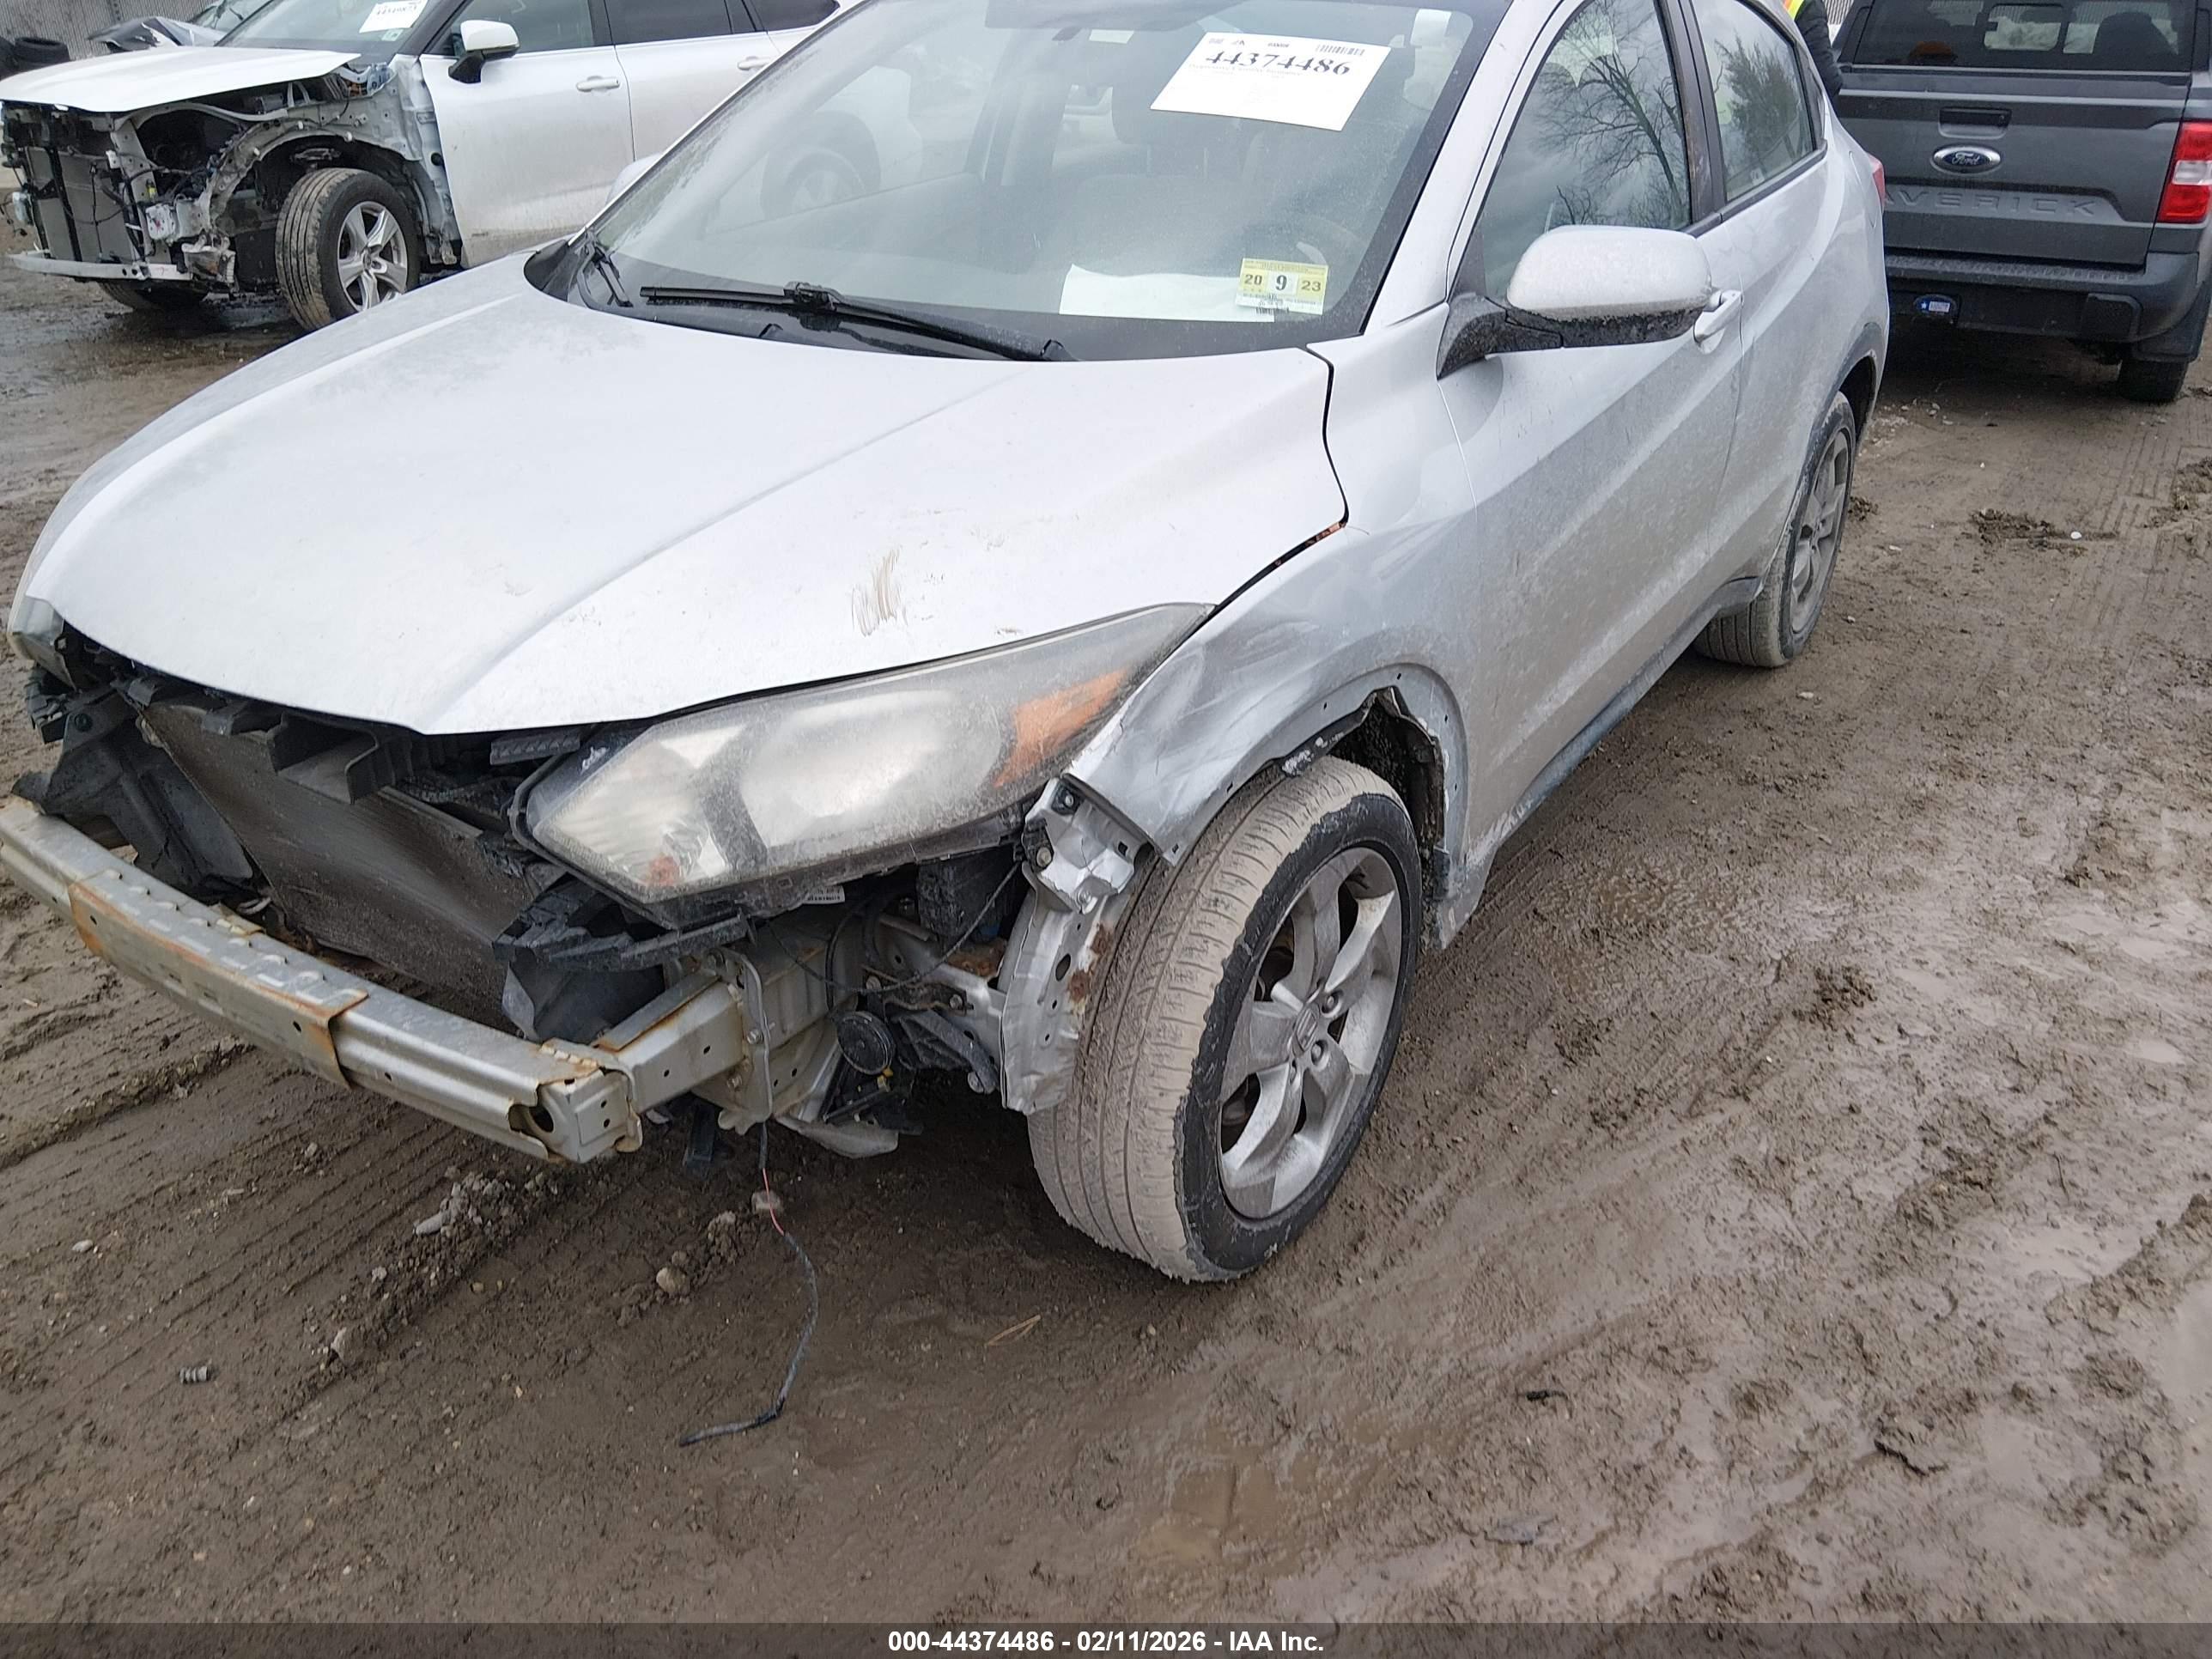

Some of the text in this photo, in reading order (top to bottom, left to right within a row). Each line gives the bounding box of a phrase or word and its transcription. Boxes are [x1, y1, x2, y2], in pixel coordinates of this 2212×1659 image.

[1206, 51, 1352, 76] 44374486
[1951, 151, 1980, 166] Ford
[1244, 274, 1322, 292] 20 9 23
